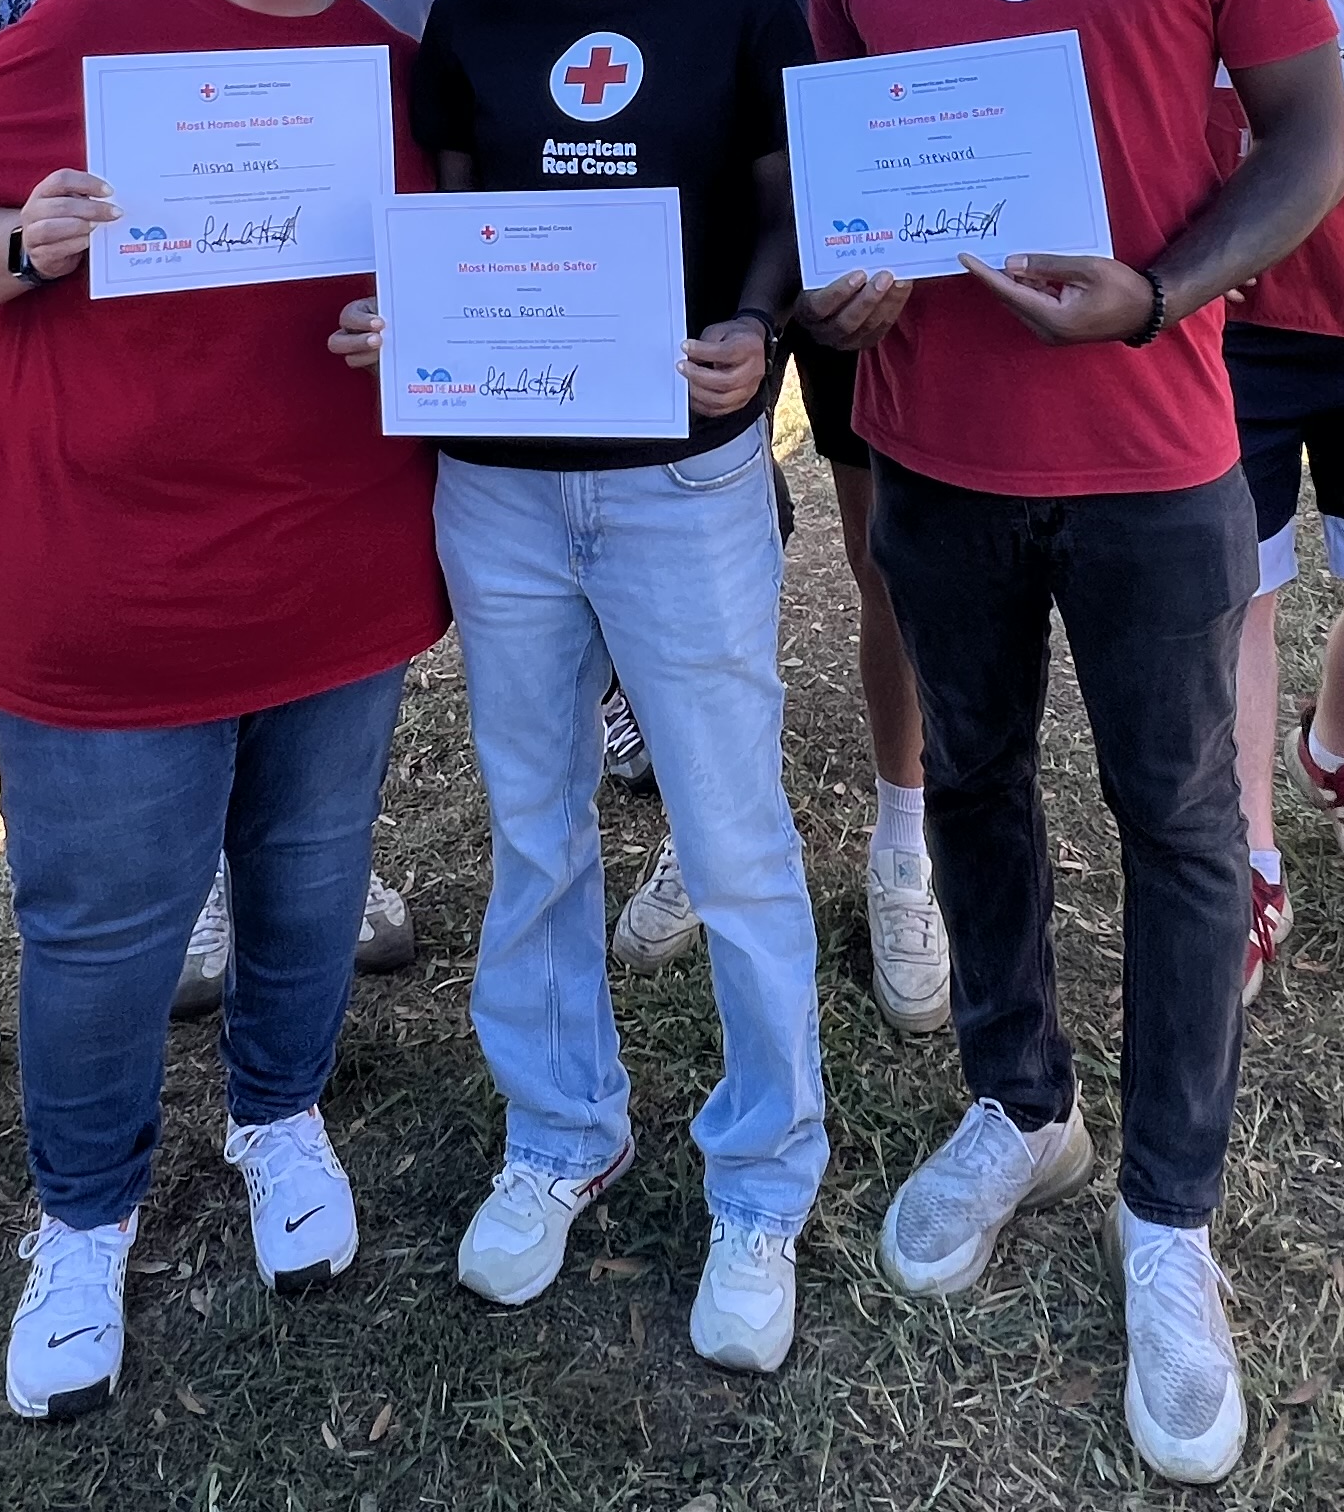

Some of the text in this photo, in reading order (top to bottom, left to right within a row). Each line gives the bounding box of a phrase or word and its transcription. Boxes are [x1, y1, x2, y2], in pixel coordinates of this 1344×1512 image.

[176, 115, 314, 131] Most Homes Made Safter
[869, 106, 1005, 129] Most Homes Made Safter
[542, 139, 637, 157] American
[919, 146, 976, 165] Steward
[242, 158, 280, 174] Hayes
[542, 156, 638, 175] Red Cross
[119, 239, 192, 255] SOUND THE ALARM
[824, 231, 893, 247] SOUND THE ALARM
[458, 263, 486, 273] Most
[488, 262, 527, 273] Homes
[530, 261, 560, 272] Made
[408, 383, 476, 394] SOUND THE ALARM
